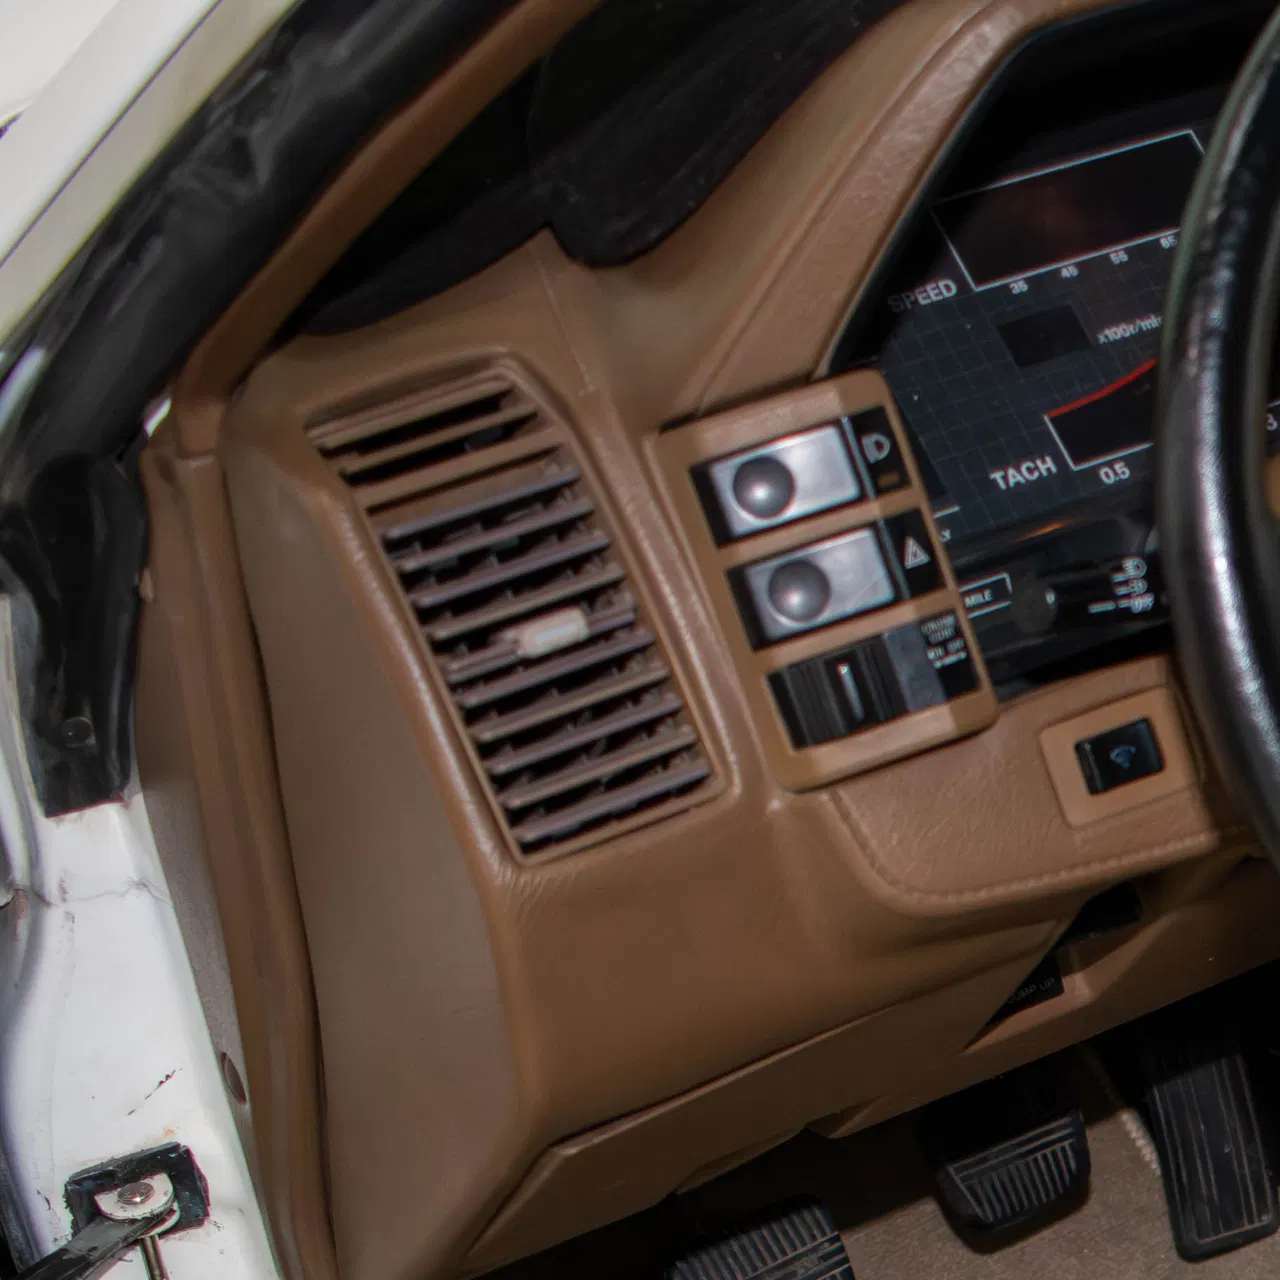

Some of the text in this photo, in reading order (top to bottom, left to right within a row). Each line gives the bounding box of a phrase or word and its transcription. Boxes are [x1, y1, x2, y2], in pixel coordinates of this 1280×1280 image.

[888, 279, 958, 312] SPEED
[990, 456, 1057, 490] TACH
[1099, 462, 1131, 485] 0.5
